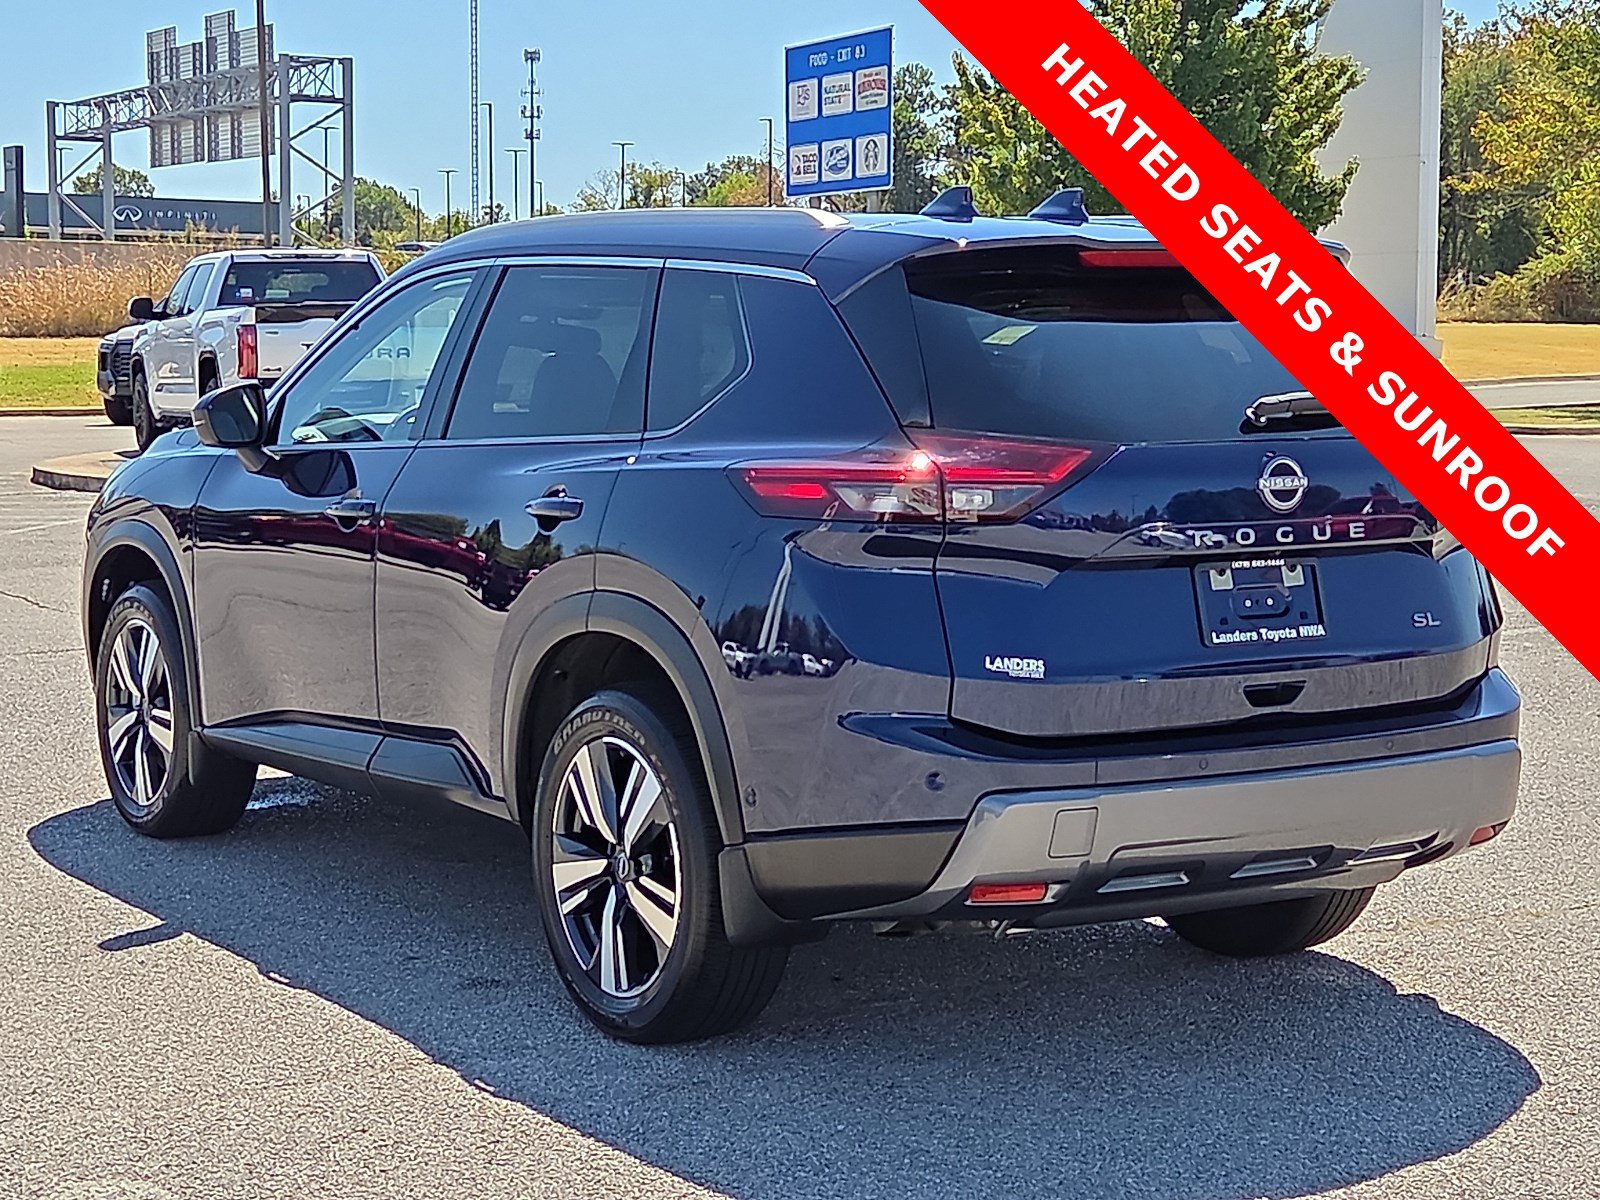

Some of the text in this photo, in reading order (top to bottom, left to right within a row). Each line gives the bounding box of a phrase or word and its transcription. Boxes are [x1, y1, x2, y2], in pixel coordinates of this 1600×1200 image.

[809, 52, 829, 67] FOOD
[837, 46, 851, 62] EXIT
[824, 82, 851, 95] NATURAL
[824, 94, 842, 106] STATE
[802, 152, 817, 164] TACO
[802, 163, 817, 175] BELL
[148, 209, 217, 221] INFINITI
[1260, 477, 1307, 489] NISSAN
[1193, 522, 1366, 547] ROGUE
[1412, 611, 1441, 628] SL
[1211, 624, 1327, 644] Landers Toyota NWA
[984, 655, 1046, 672] LANDERS
